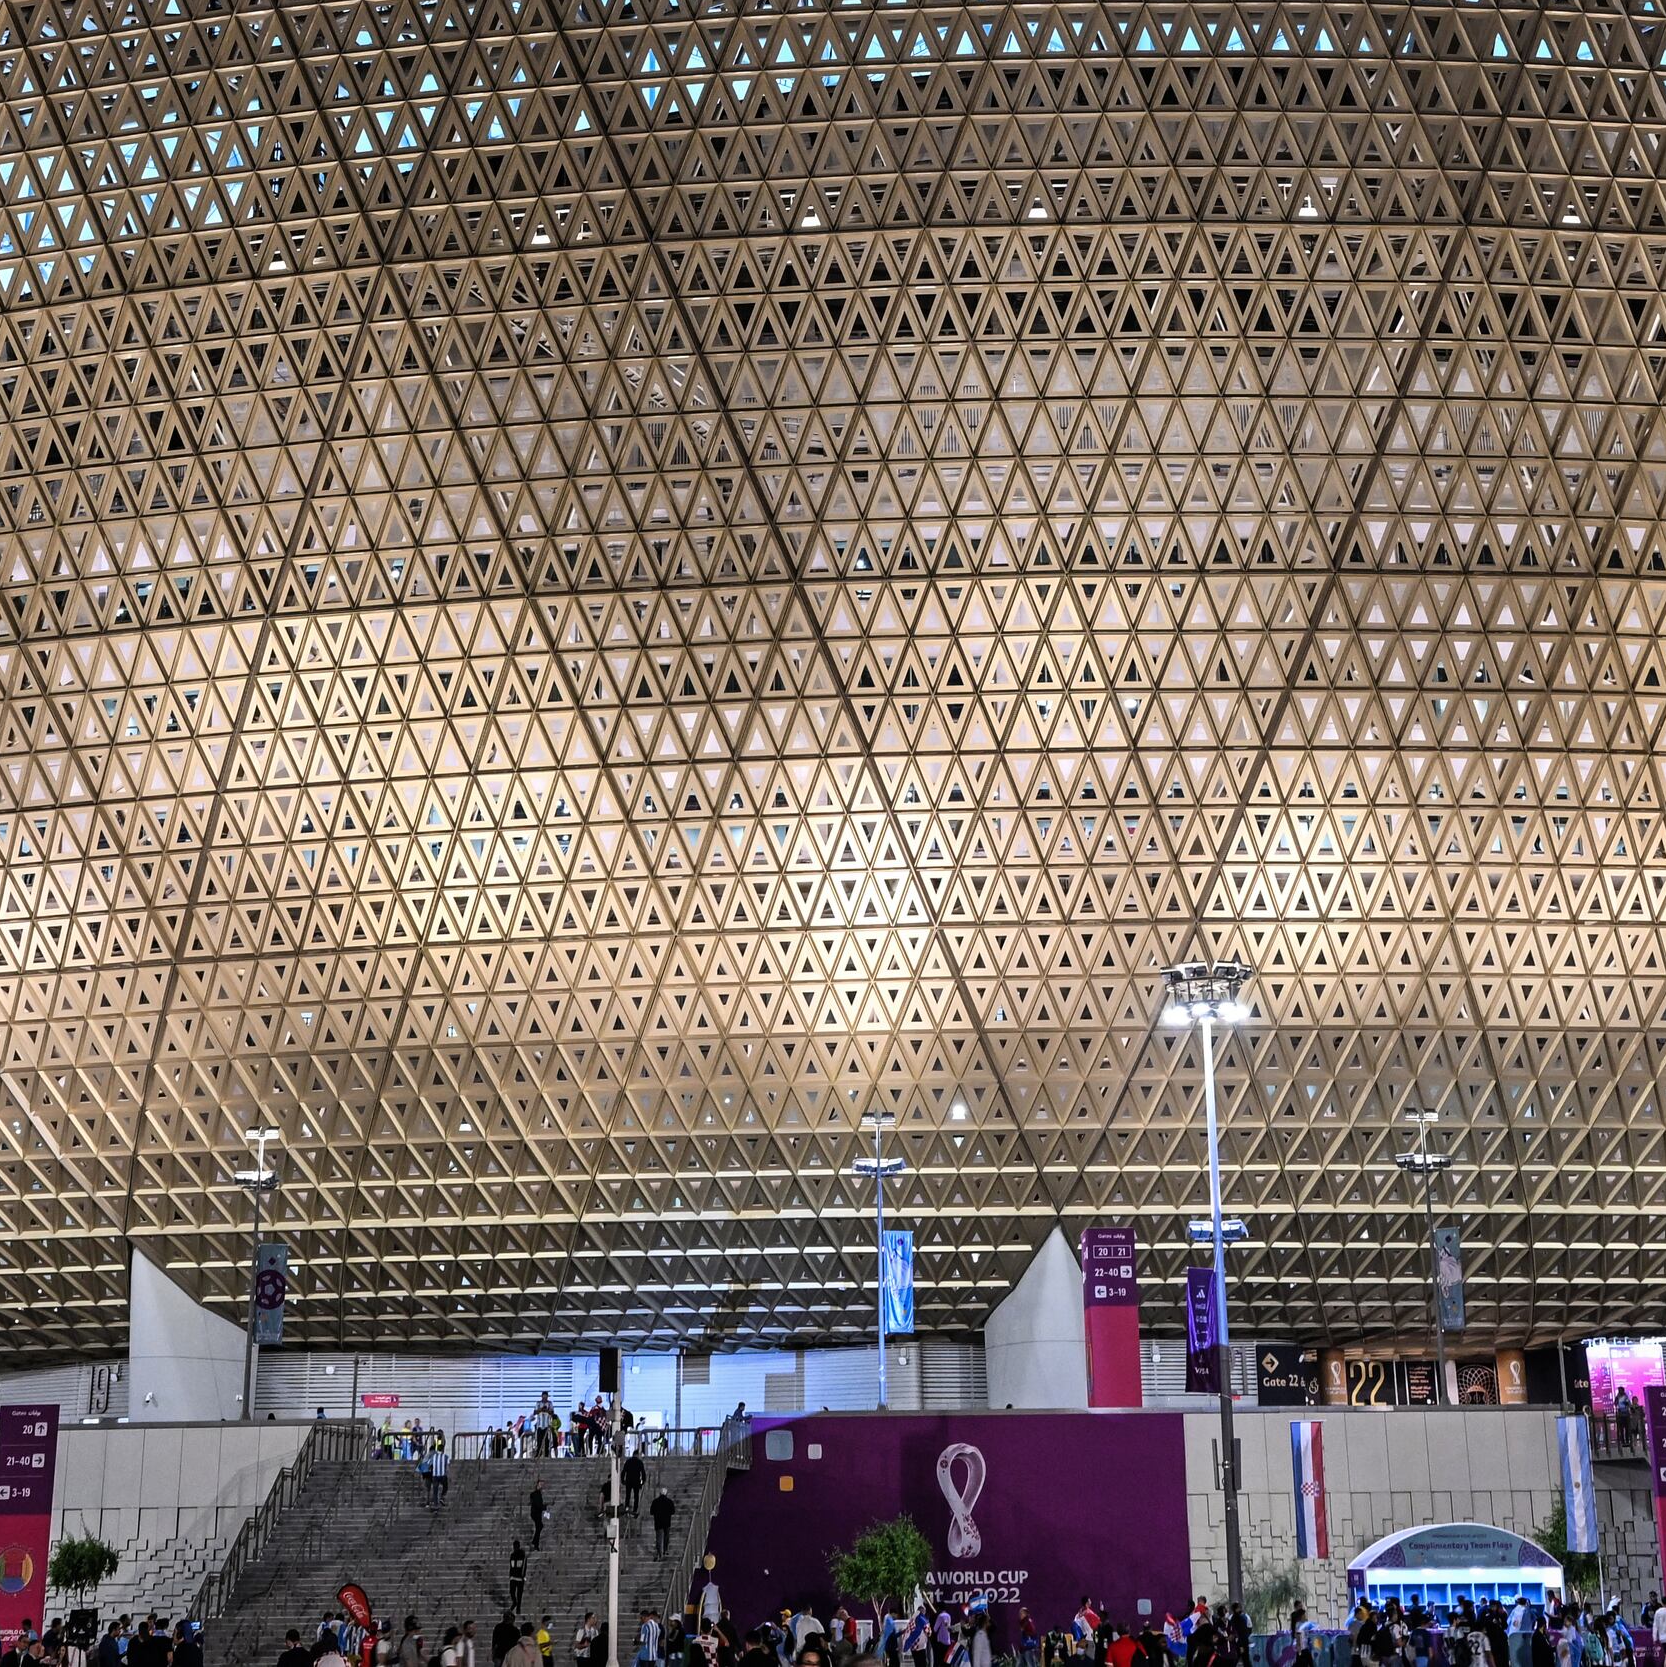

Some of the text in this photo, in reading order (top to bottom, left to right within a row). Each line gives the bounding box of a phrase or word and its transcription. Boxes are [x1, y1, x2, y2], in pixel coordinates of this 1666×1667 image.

[1098, 1248, 1108, 1256] 20
[1117, 1248, 1126, 1256] 21
[1094, 1268, 1118, 1277] 22-40
[1109, 1288, 1126, 1296] 3-19
[1263, 1377, 1286, 1387] Gate
[1289, 1374, 1298, 1387] 22
[1350, 1361, 1387, 1406] 22
[87, 1366, 111, 1415] 19
[23, 1425, 33, 1434] 20
[6, 1456, 30, 1466] 21-40
[12, 1488, 31, 1497] 3-19
[1408, 1542, 1468, 1550] Complimentary
[1493, 1541, 1512, 1550] Flags
[937, 1571, 994, 1584] WORLD
[998, 1570, 1028, 1584] CUP
